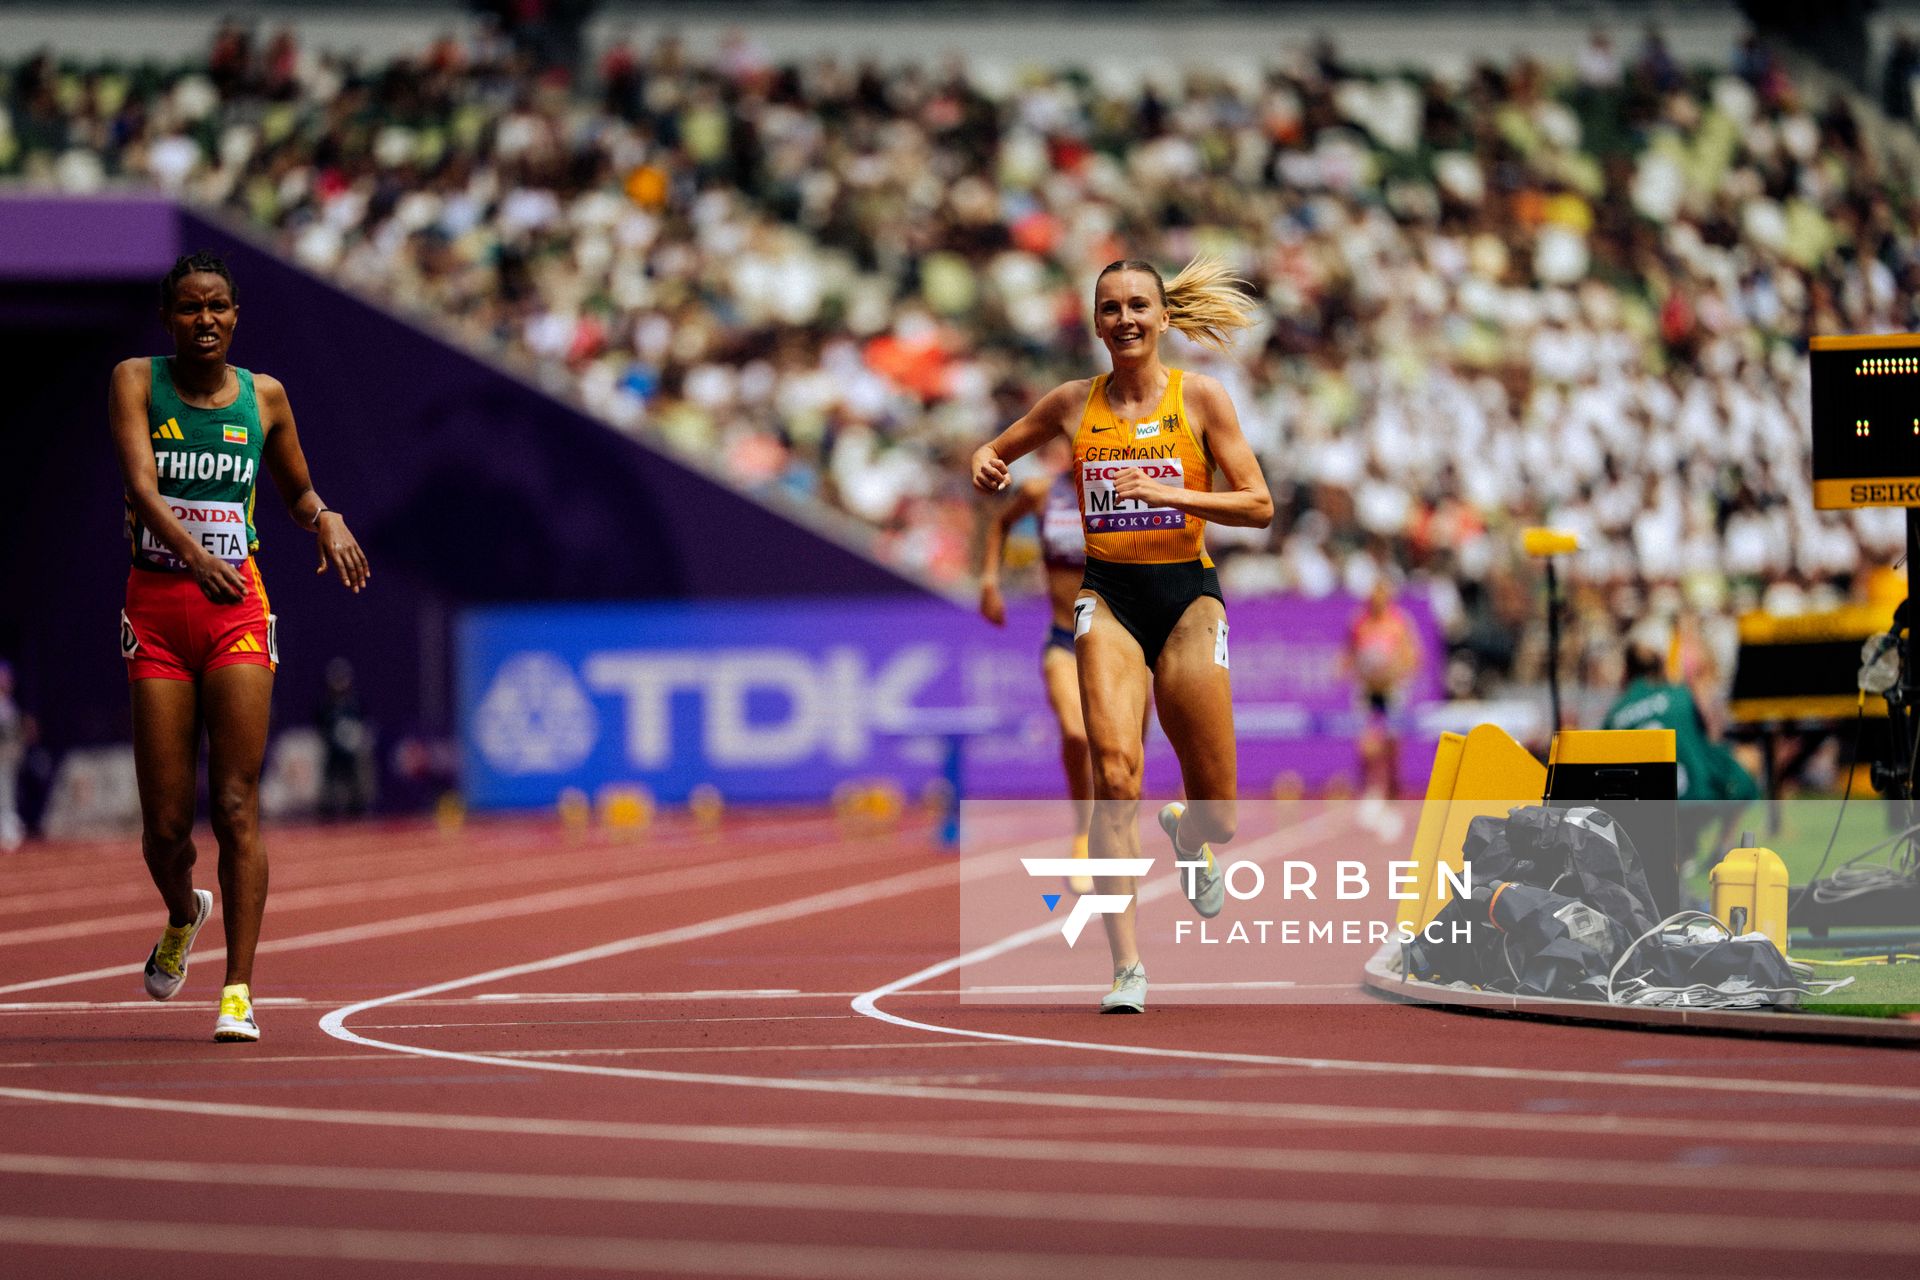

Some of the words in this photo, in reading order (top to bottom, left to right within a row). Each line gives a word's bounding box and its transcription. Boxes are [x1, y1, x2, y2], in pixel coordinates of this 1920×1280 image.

[1085, 443, 1175, 461] GERMANY
[155, 451, 254, 486] THIOPIA
[1850, 484, 1920, 503] SEIK
[168, 504, 243, 524] ONDA
[149, 530, 243, 556] META
[587, 648, 942, 768] TDK
